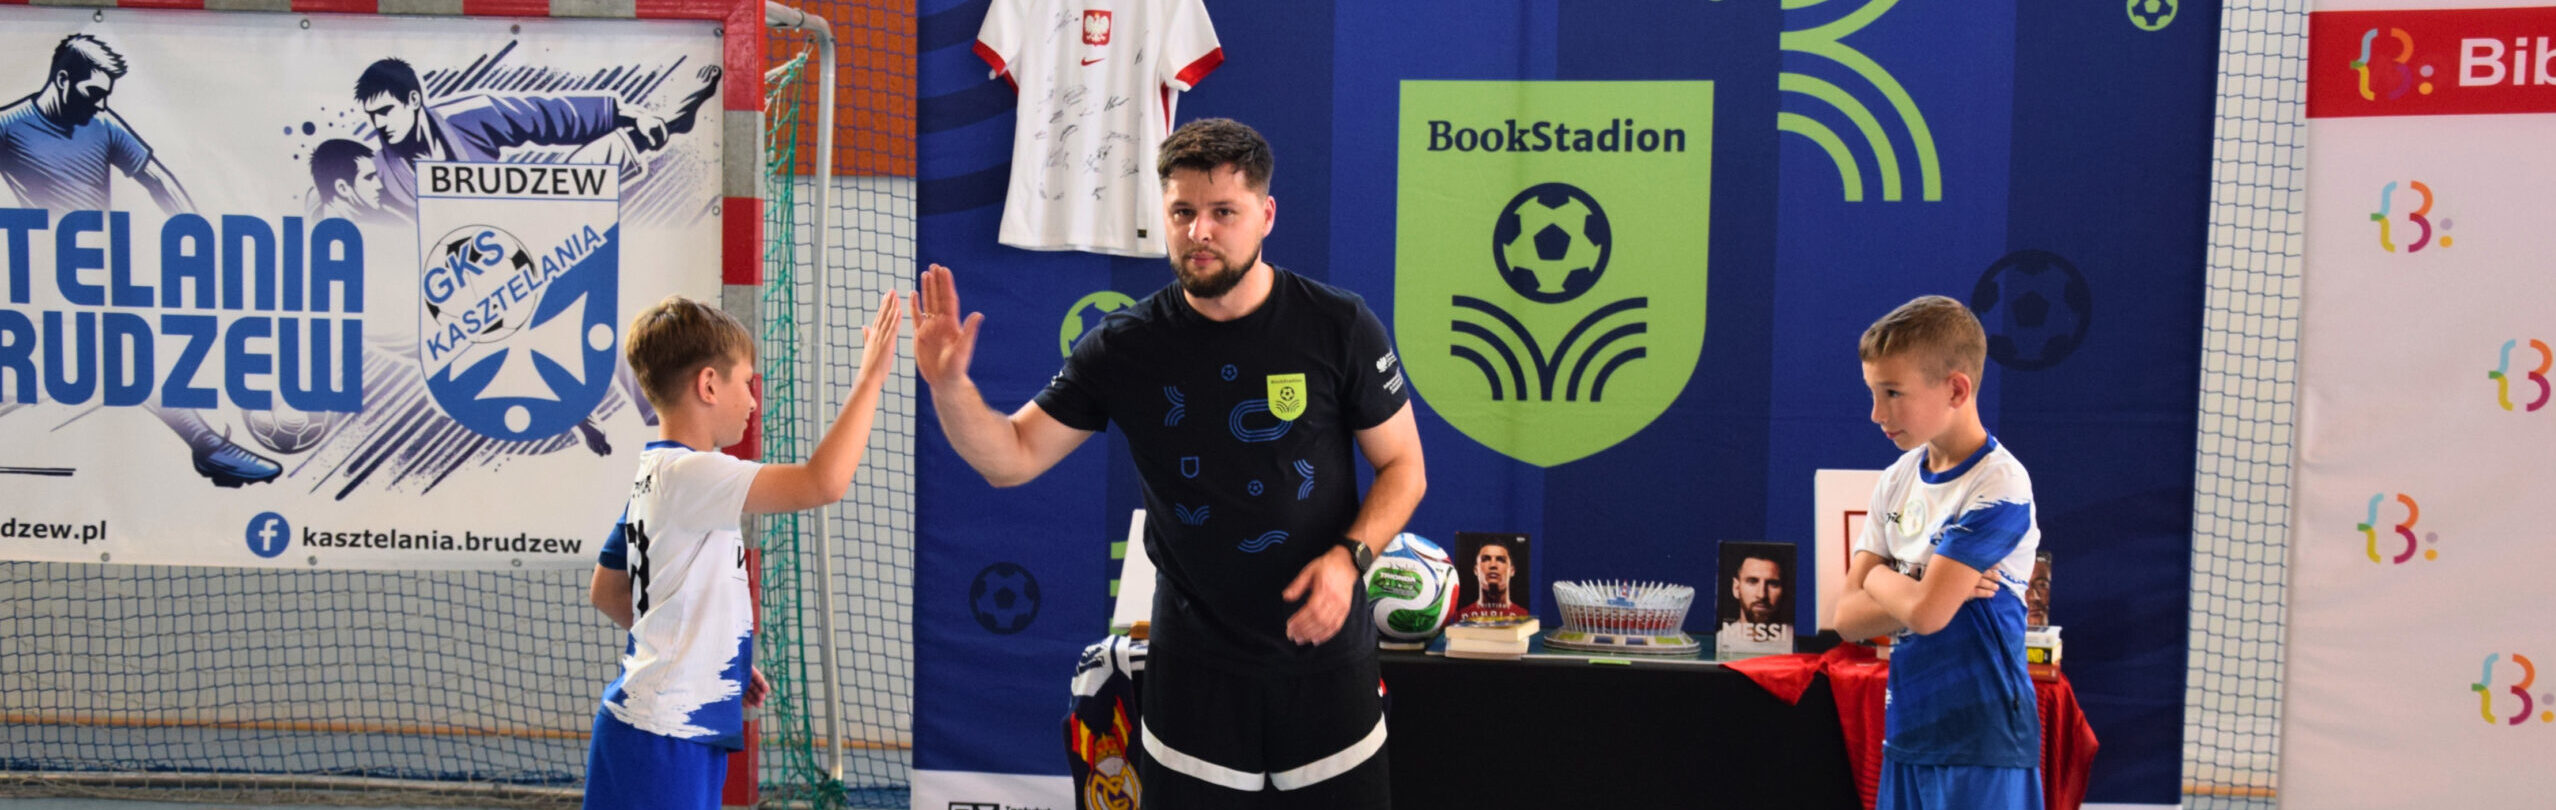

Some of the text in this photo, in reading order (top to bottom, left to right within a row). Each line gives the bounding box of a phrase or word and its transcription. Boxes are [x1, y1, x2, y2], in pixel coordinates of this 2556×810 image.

[1427, 118, 1686, 152] BookStadion
[431, 166, 607, 195] BRUDZEW
[0, 208, 364, 313] TELANIA
[424, 231, 504, 304] GKS
[426, 224, 602, 361] KASZTELANIA
[0, 309, 363, 413] RUDZEW
[0, 518, 107, 544] dzew.pl
[303, 527, 583, 554] kasztelania.brudzew
[1722, 621, 1788, 641] MESSI
